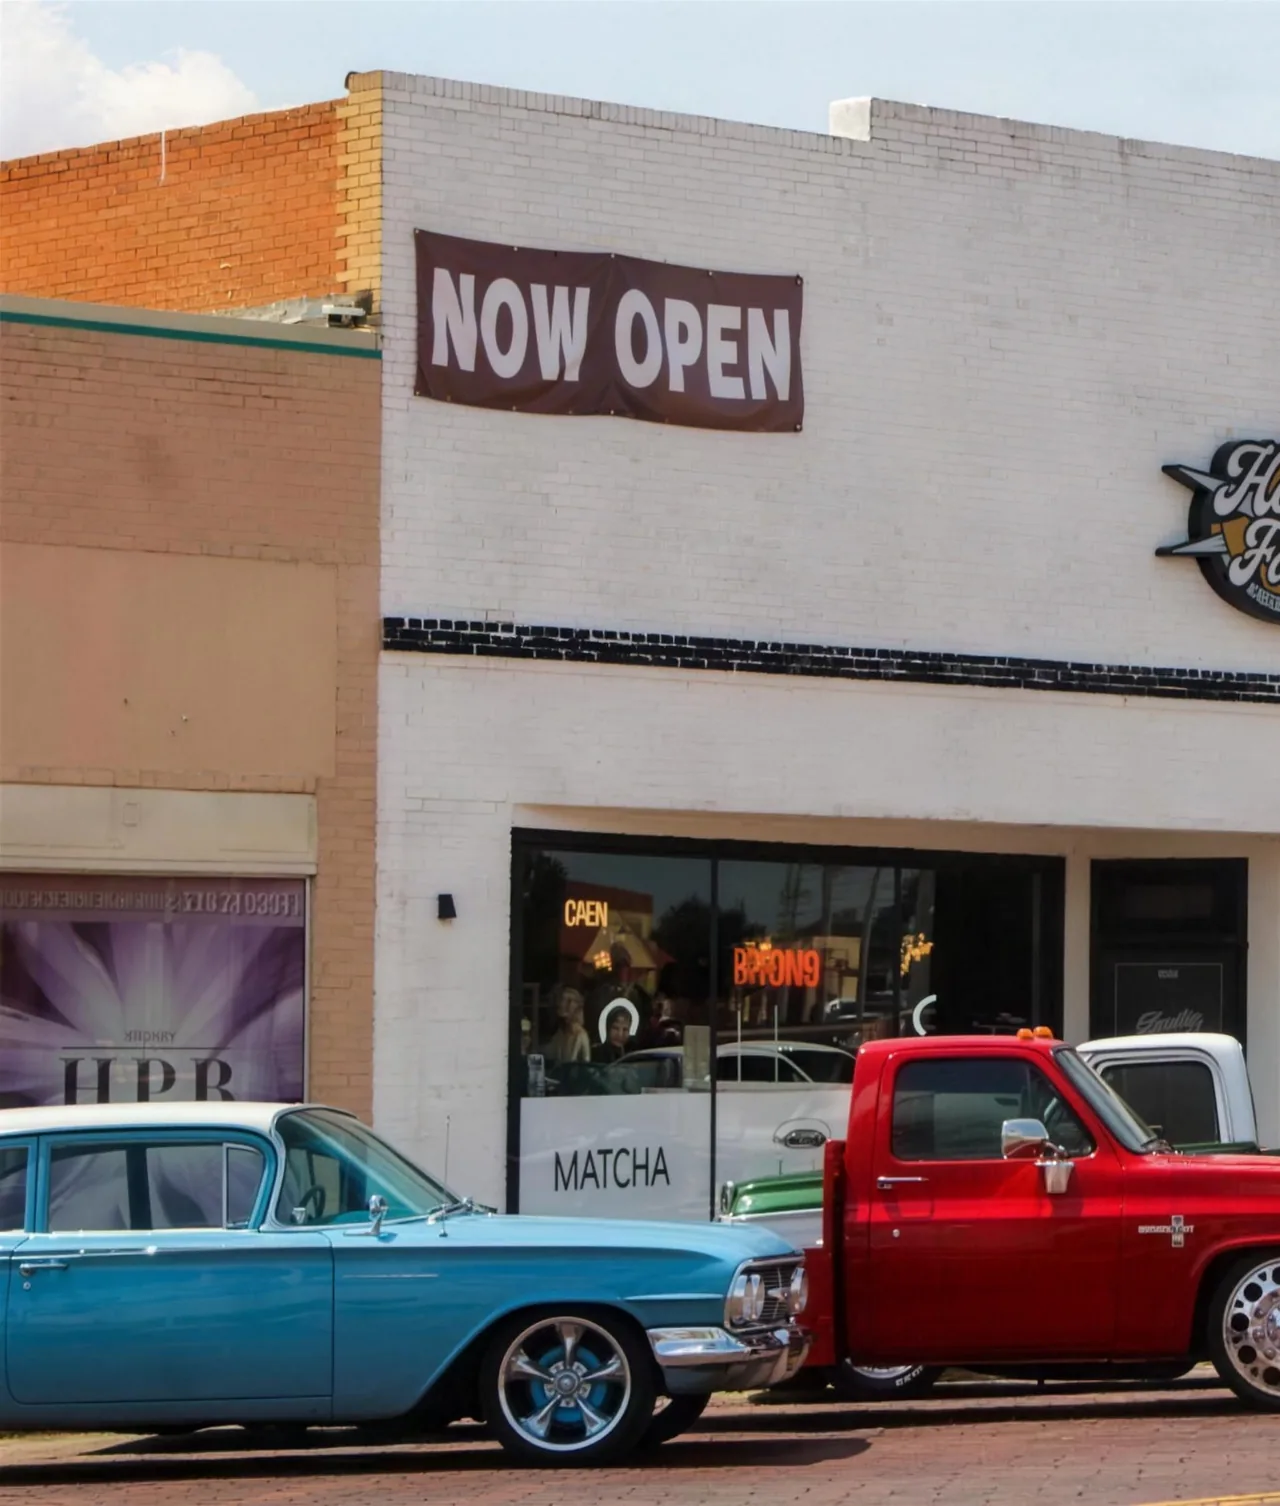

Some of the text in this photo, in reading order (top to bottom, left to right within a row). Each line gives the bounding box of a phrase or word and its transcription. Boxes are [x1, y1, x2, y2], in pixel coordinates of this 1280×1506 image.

[432, 268, 791, 401] NOW OPEN
[554, 1146, 670, 1192] MATCHA
